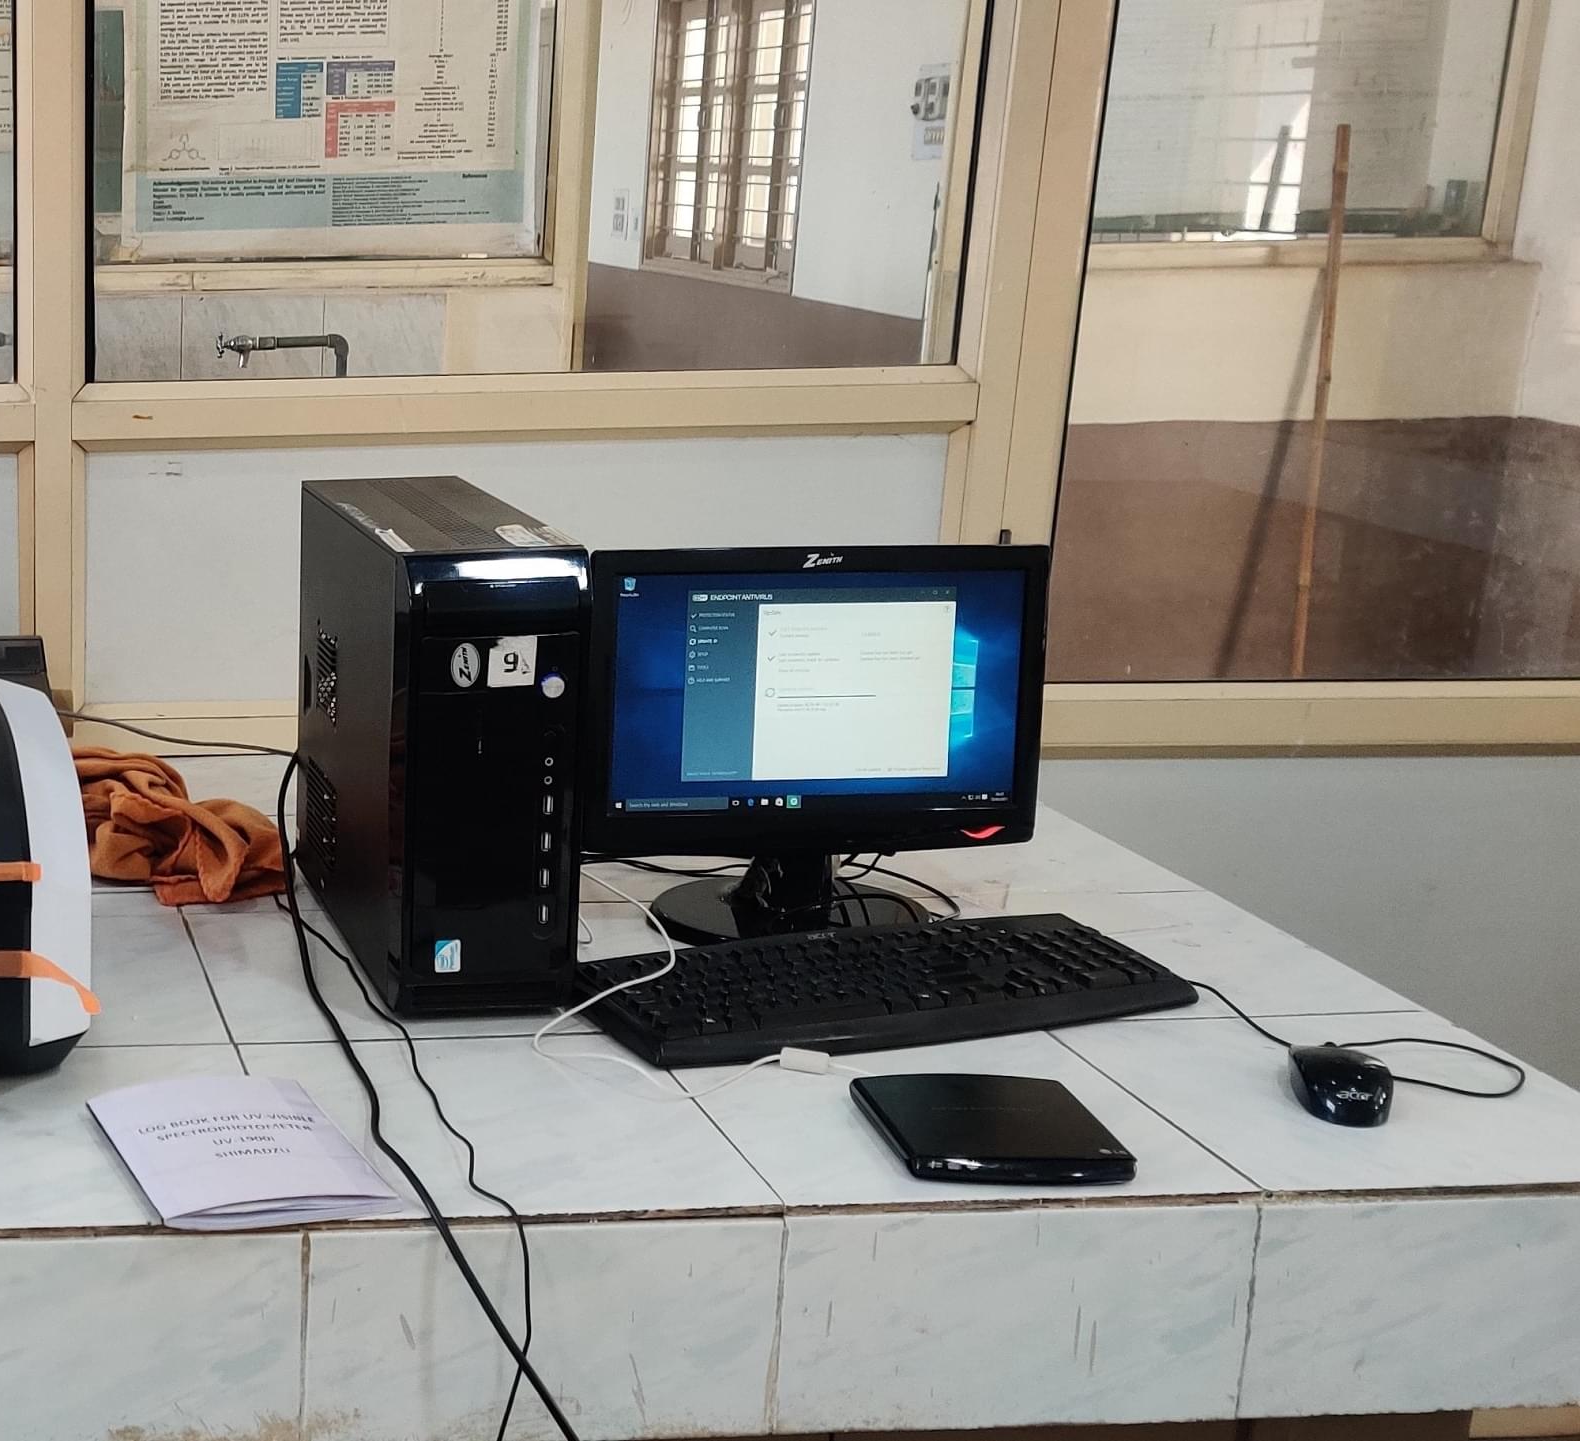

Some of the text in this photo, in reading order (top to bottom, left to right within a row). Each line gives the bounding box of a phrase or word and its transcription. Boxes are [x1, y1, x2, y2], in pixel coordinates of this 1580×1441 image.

[1336, 1090, 1373, 1101] acer
[138, 1124, 166, 1135] LOG
[170, 1117, 208, 1129] BOOK
[212, 1114, 240, 1123] FOR
